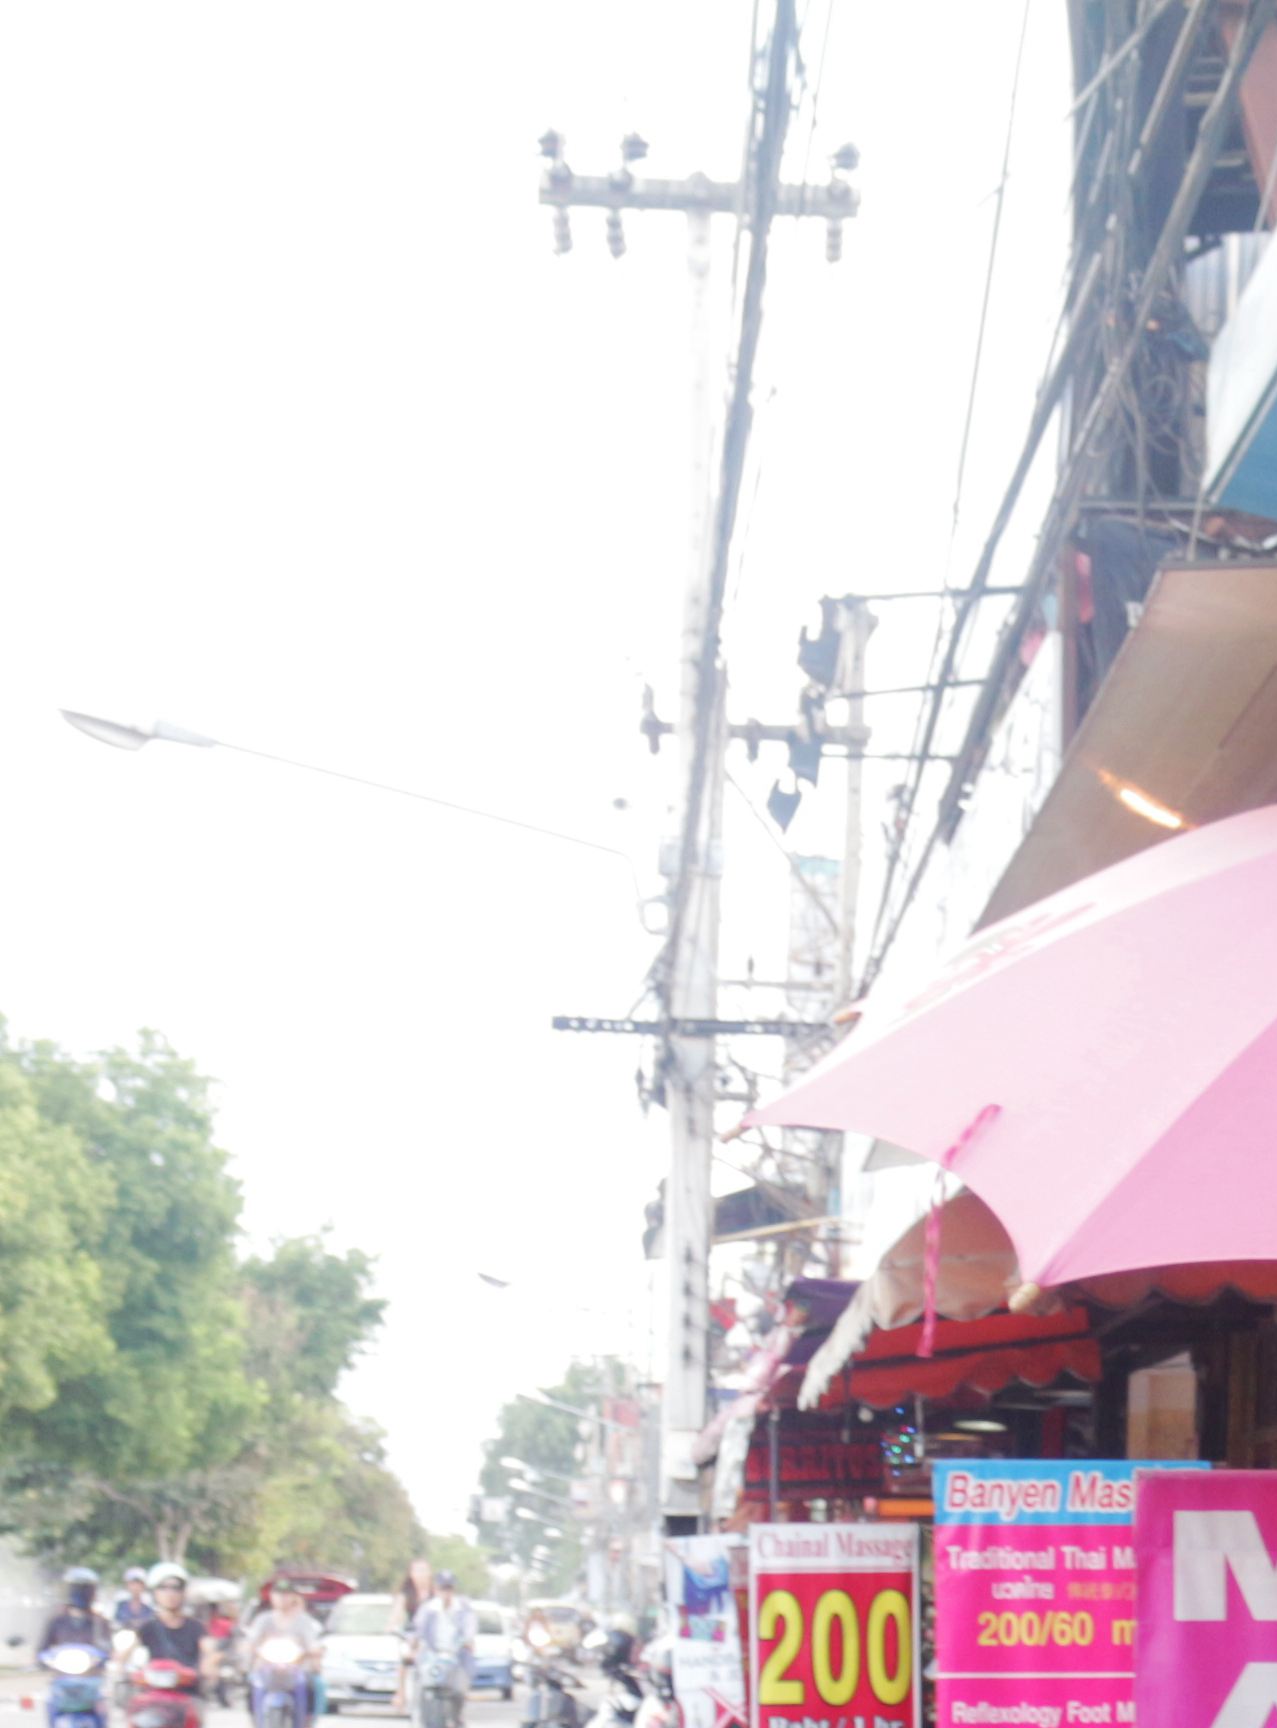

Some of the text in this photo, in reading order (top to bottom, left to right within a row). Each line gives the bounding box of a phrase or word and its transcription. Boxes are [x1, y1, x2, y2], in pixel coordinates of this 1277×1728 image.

[946, 1472, 1061, 1521] Banyen
[946, 1545, 1055, 1571] Traditional
[1060, 1545, 1107, 1571] Thai
[977, 1610, 1095, 1647] 200/60
[758, 1589, 912, 1706] 200
[952, 1700, 1062, 1728] Reflexology
[1066, 1700, 1112, 1724] Foot
